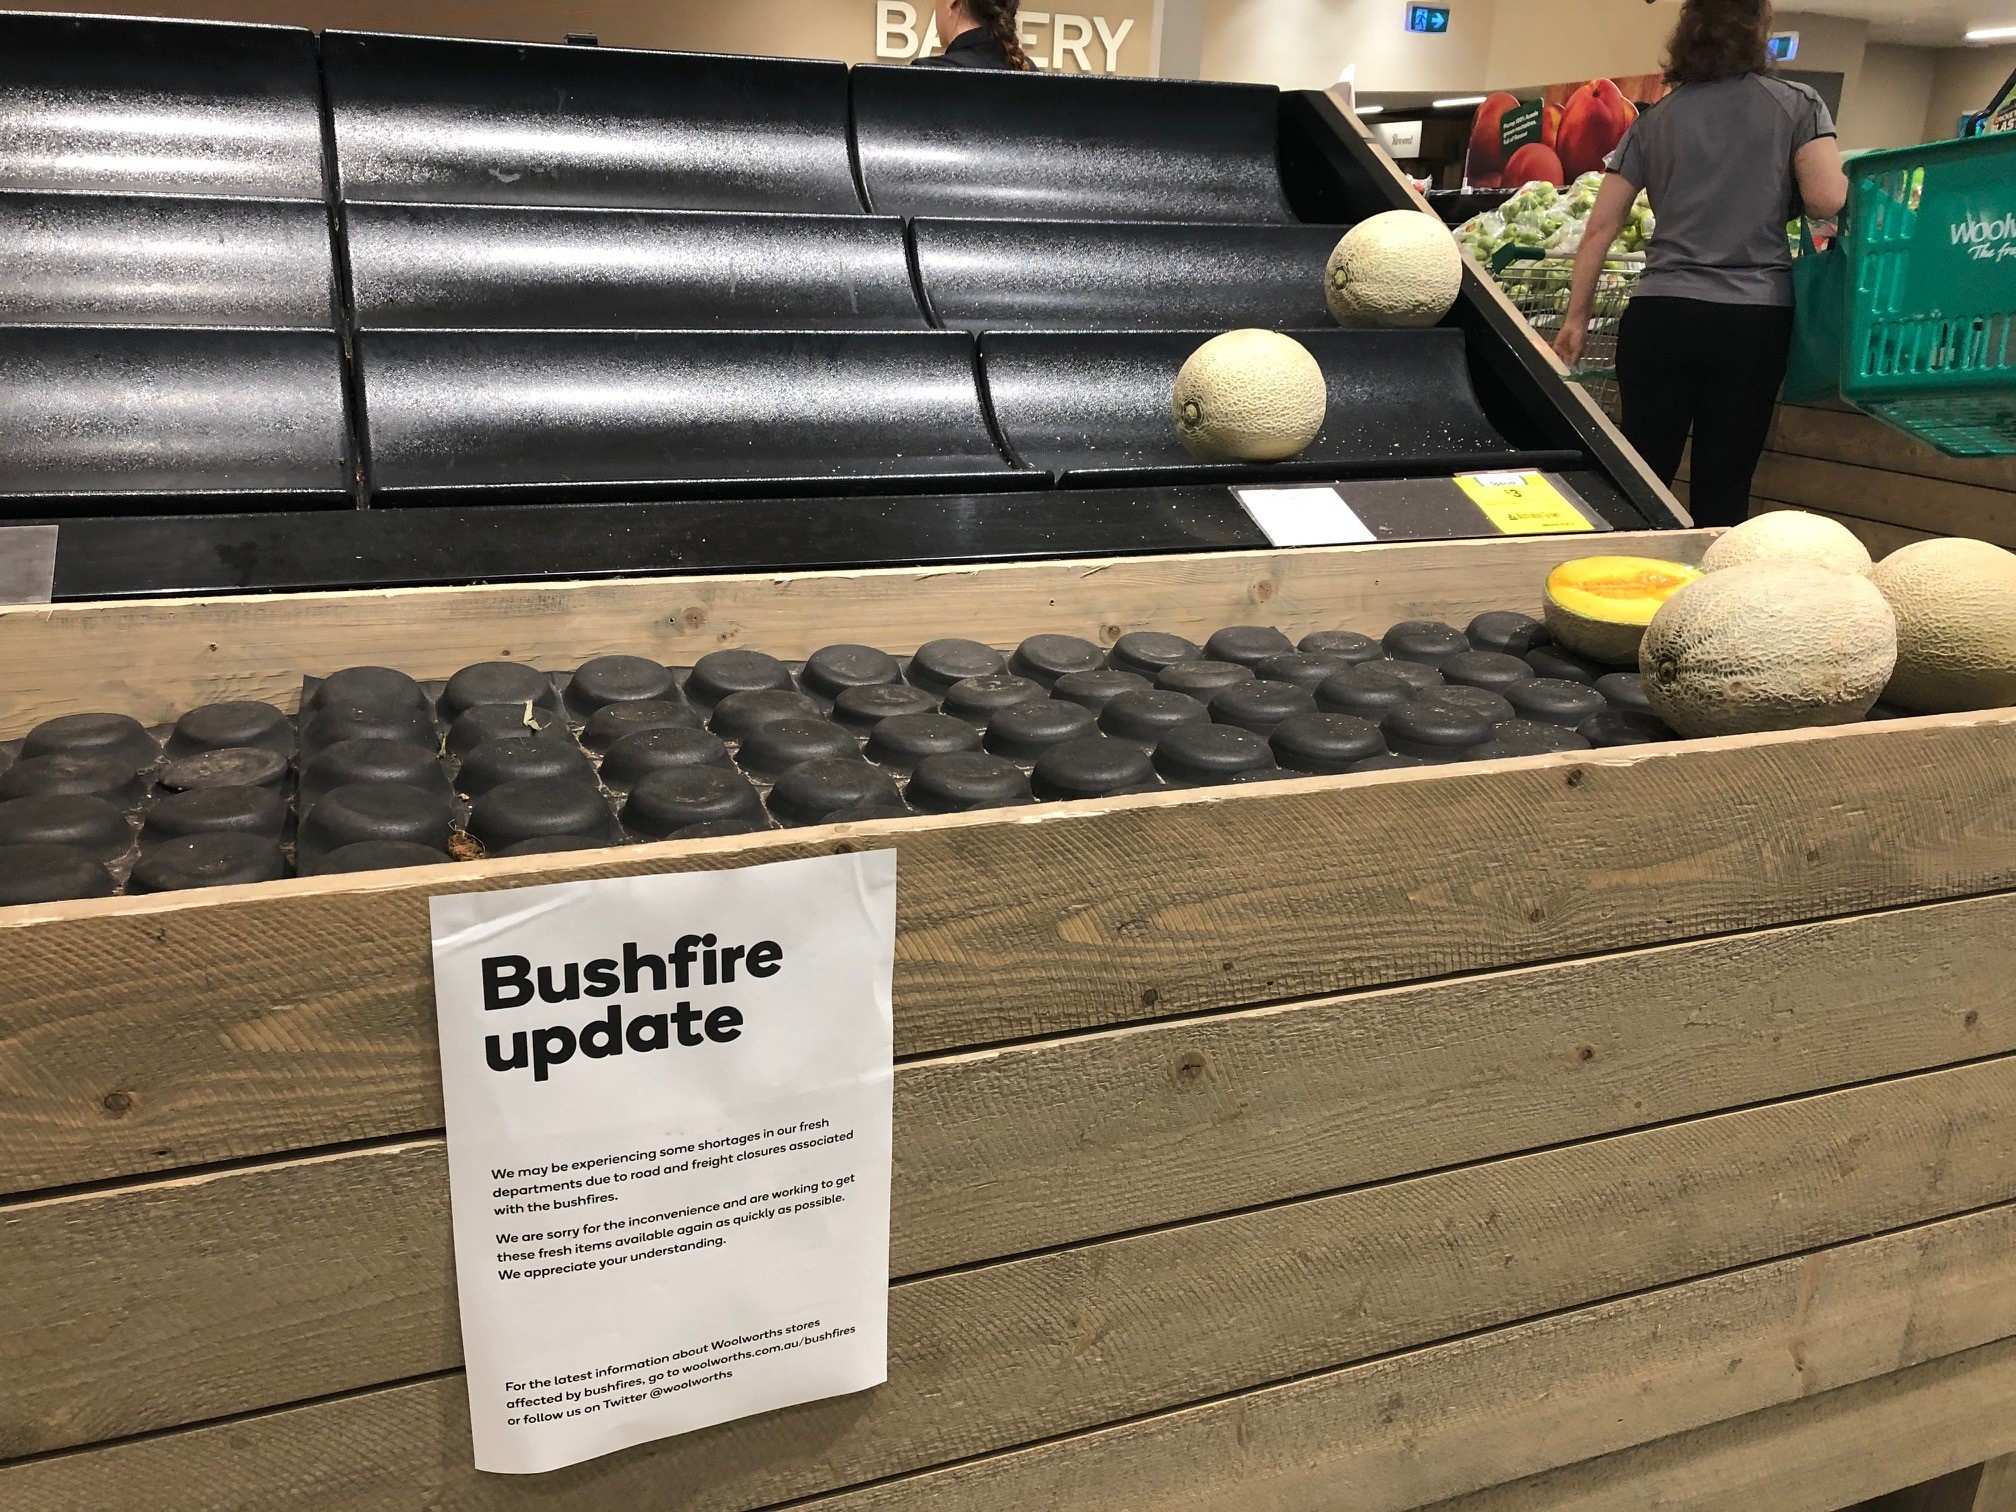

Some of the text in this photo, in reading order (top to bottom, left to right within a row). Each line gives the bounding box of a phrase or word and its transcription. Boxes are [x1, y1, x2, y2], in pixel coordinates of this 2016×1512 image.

[1967, 241, 1996, 260] The
[481, 933, 783, 1011] Bushfire
[485, 1001, 743, 1082] update
[491, 1118, 829, 1180] We may be experiencing some shortages in our fresh
[492, 1129, 853, 1199] departments due to road and freight closures associated
[494, 1194, 618, 1215] with the bushfires.
[496, 1174, 855, 1244] We are sorry for the inconvenience and are working to get
[496, 1194, 845, 1262] these fresh items available again as quickly as possible.
[498, 1237, 726, 1280] We appreciate your understanding.
[505, 1320, 820, 1391] For the latest information about Woolworths stores
[506, 1326, 855, 1409] affected by bushfires, go to woolworths.com.au/bushfires
[523, 1412, 563, 1424] follow
[566, 1408, 581, 1417] us
[584, 1404, 600, 1413] on
[602, 1393, 647, 1408] Twitter
[650, 1371, 733, 1399] @woolworths
